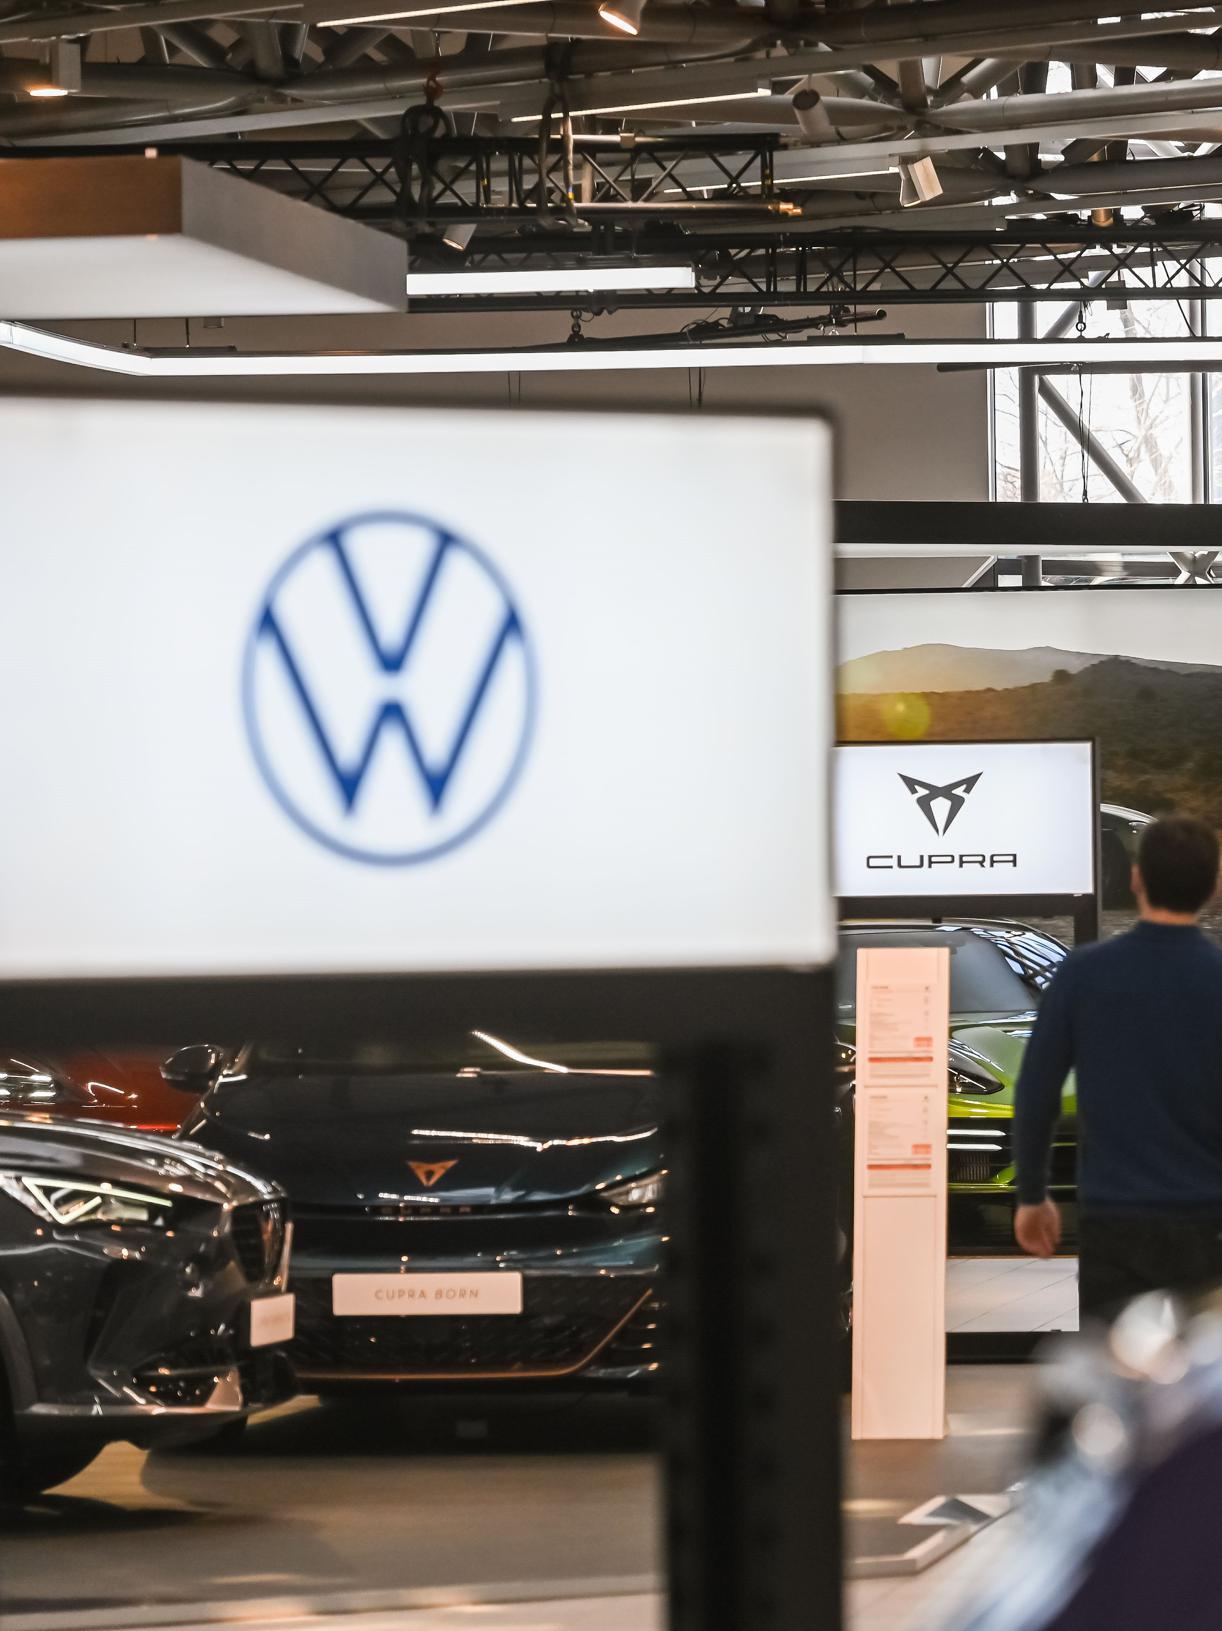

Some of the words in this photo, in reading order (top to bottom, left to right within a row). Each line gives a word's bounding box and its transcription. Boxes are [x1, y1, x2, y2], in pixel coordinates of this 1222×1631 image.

[865, 852, 1018, 870] CUPRA
[373, 1287, 427, 1301] CUPRA
[433, 1286, 480, 1300] BORN
